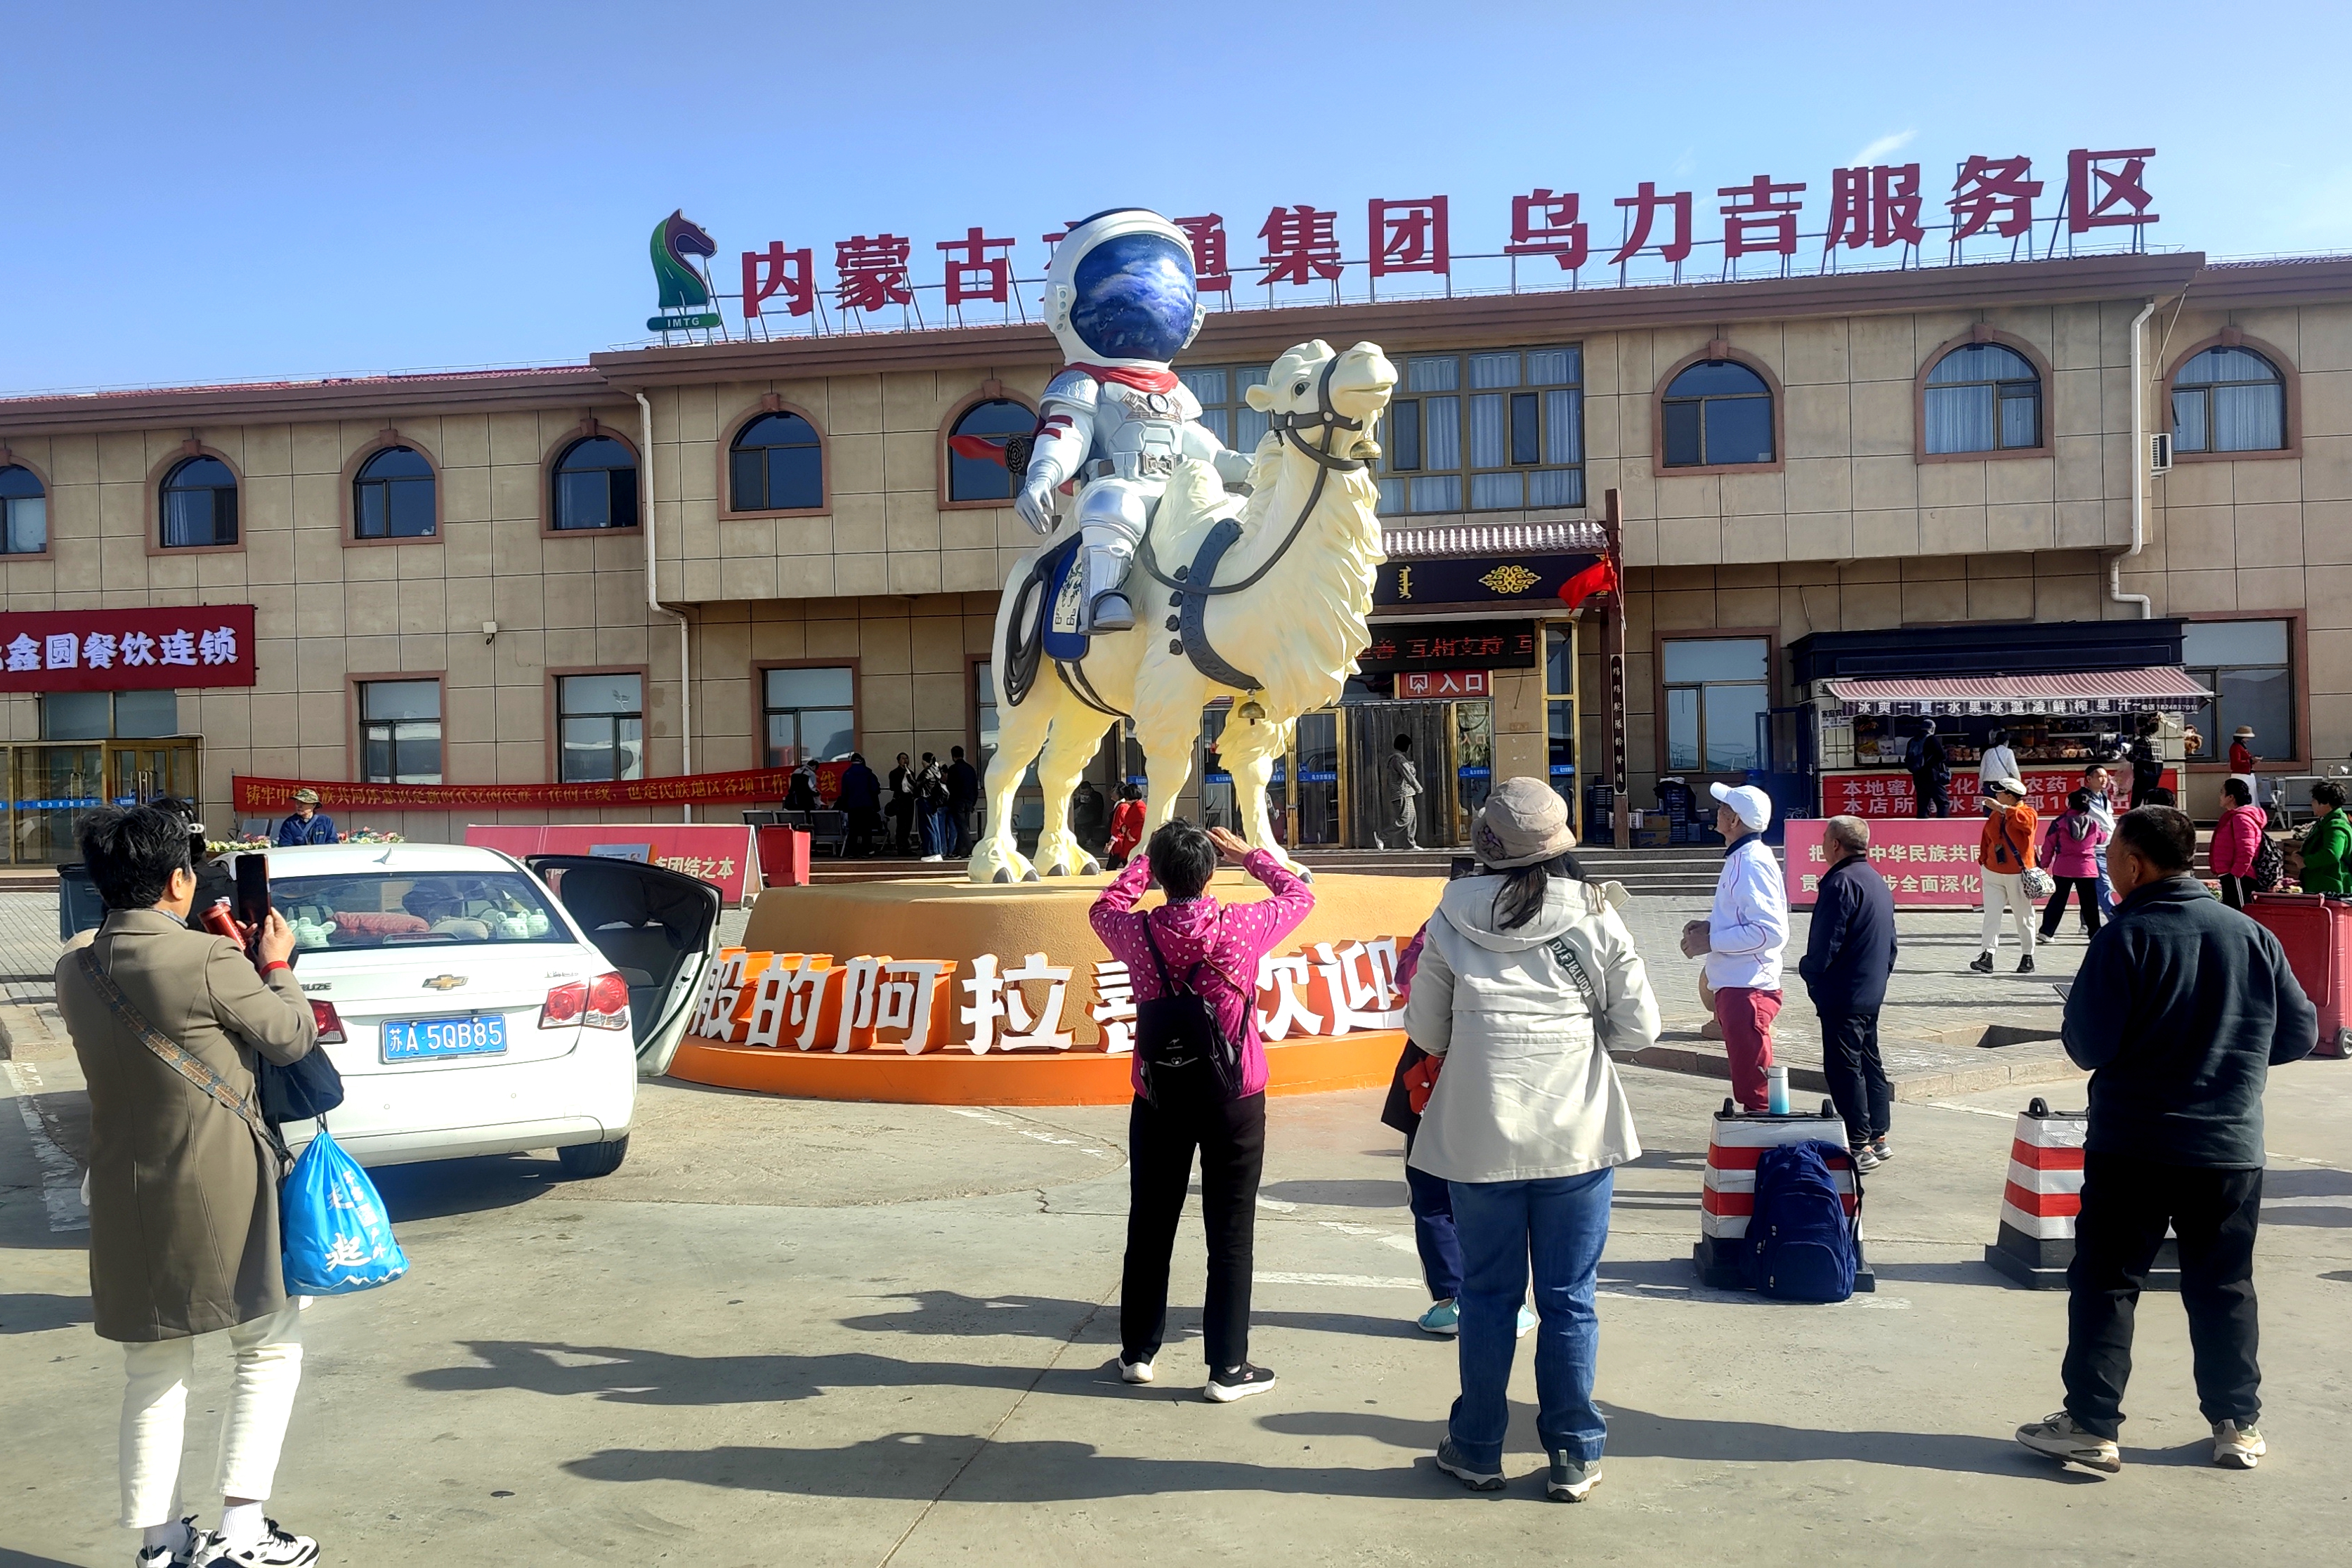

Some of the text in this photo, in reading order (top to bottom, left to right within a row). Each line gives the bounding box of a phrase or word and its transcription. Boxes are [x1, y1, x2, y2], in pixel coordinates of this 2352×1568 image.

[742, 148, 2160, 318] 内蒙古通集团 乌力吉服务区
[667, 316, 700, 328] IMTG
[0, 625, 240, 672] 鑫圆餐饮连锁
[1439, 673, 1483, 693] 入口
